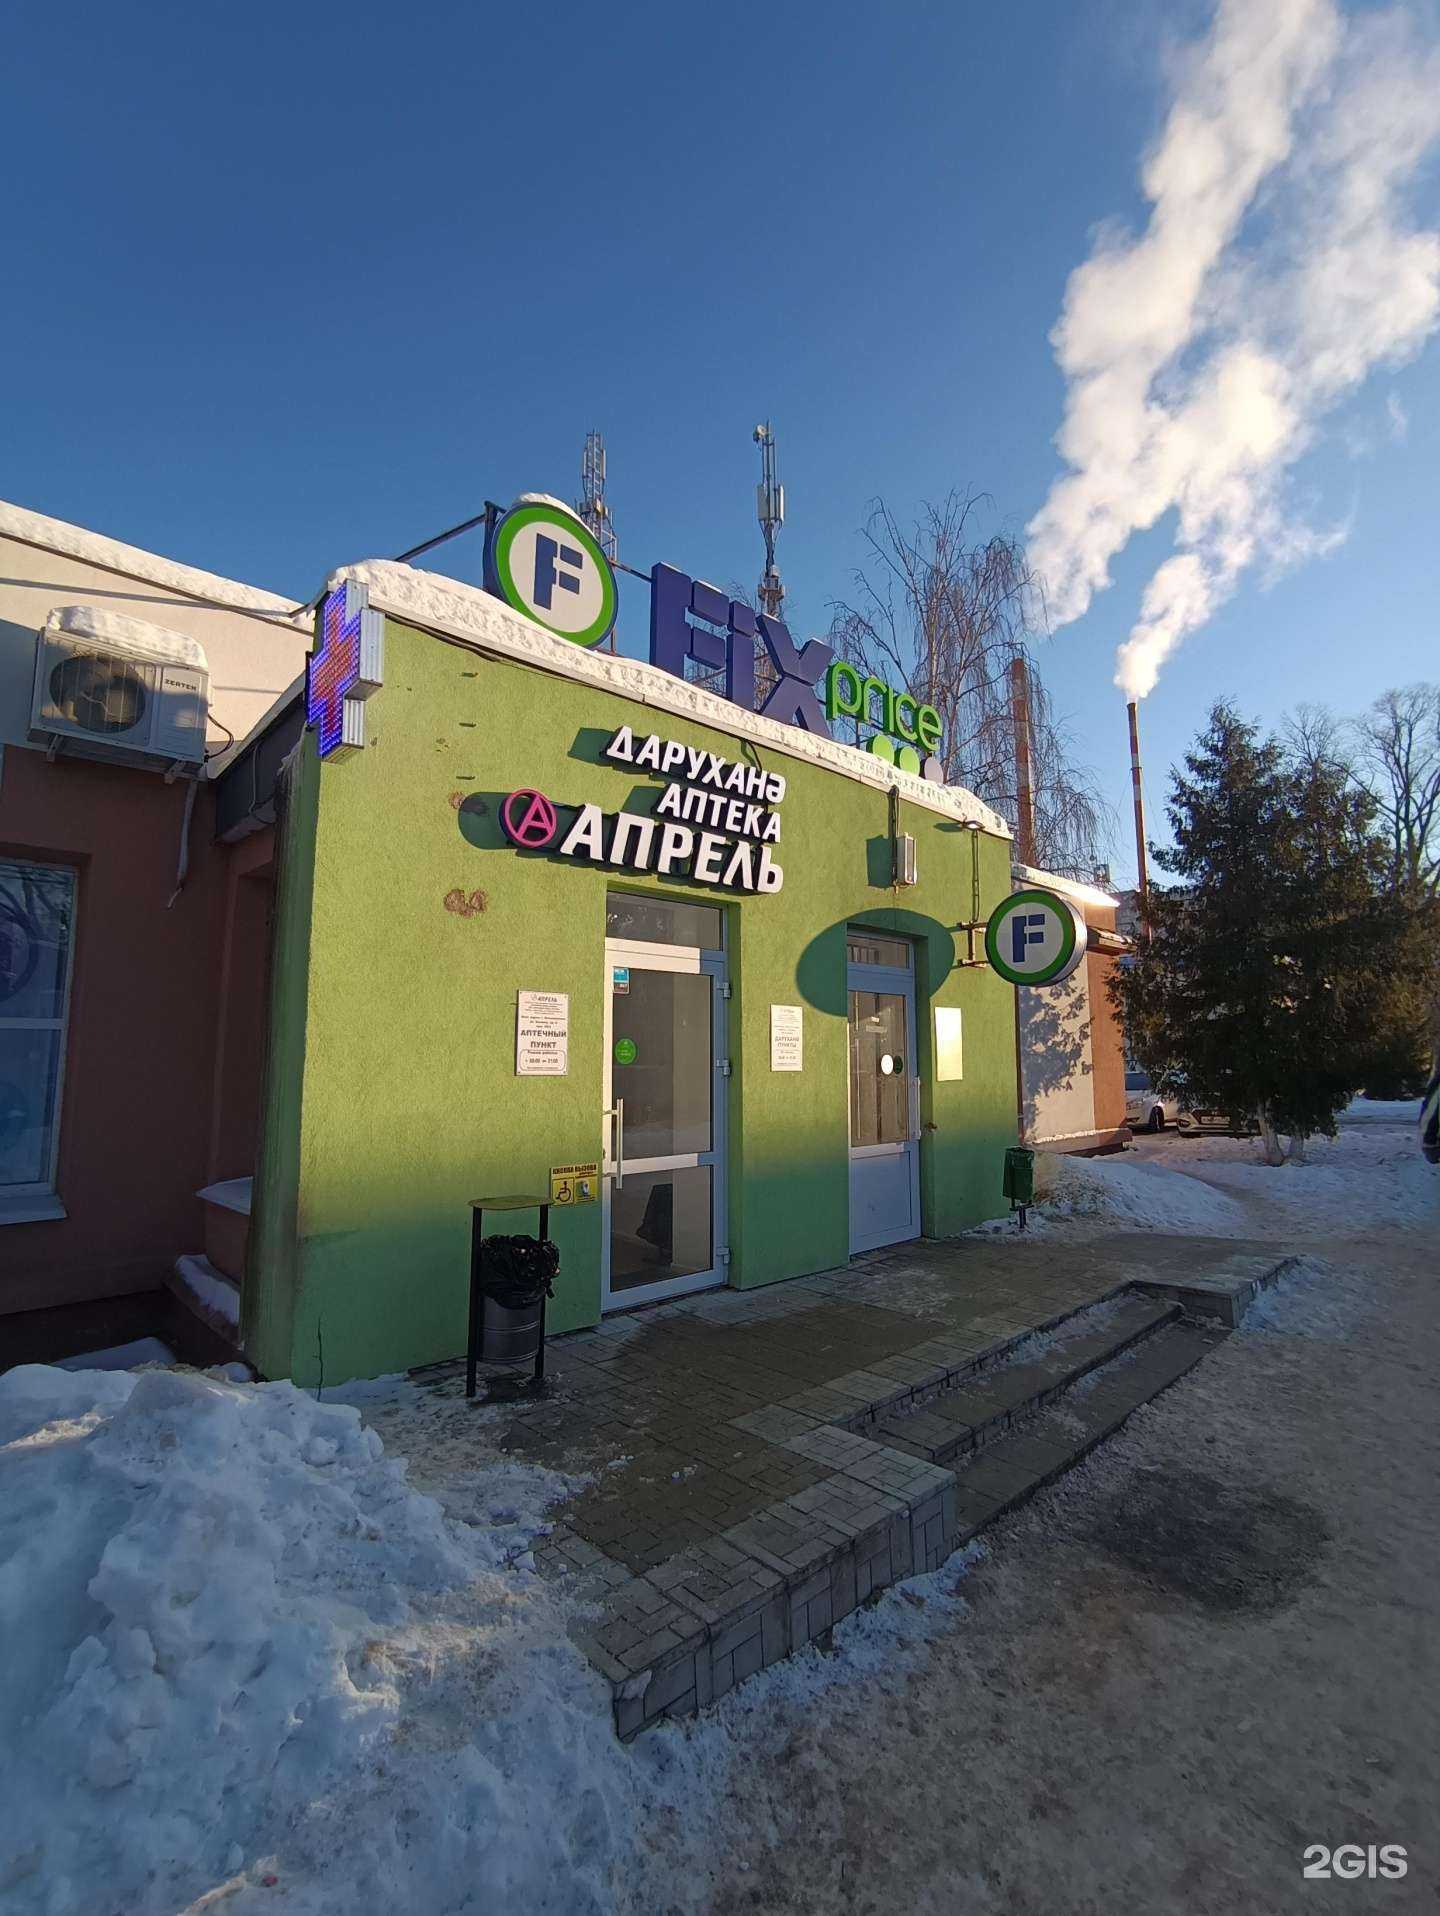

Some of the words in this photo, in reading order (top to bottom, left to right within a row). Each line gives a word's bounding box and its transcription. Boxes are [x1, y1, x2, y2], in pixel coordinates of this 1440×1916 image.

[533, 533, 583, 610] F
[825, 660, 943, 752] price
[657, 783, 781, 843] АПТЕКА
[560, 803, 784, 894] АПРЕЛЬ
[1012, 914, 1046, 963] F
[530, 1041, 557, 1049] ПУНКТ
